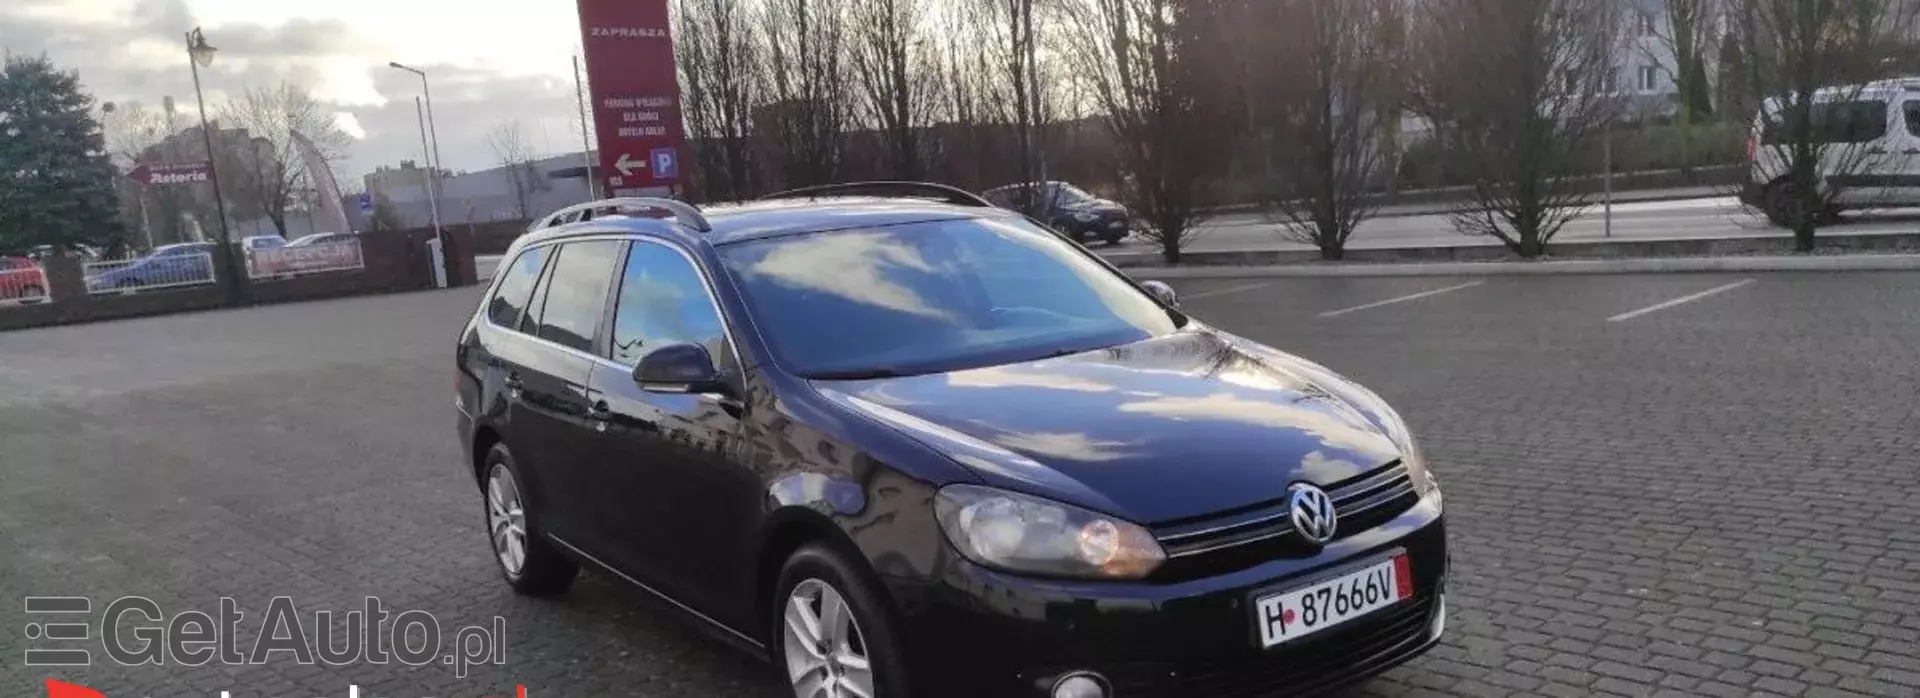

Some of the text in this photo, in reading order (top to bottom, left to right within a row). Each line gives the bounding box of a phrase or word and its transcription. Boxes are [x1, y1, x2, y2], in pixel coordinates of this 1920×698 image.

[590, 27, 666, 37] ZAPRASZA
[656, 153, 672, 173] P
[150, 171, 207, 184] Astoria
[1265, 566, 1391, 639] H 87666V
